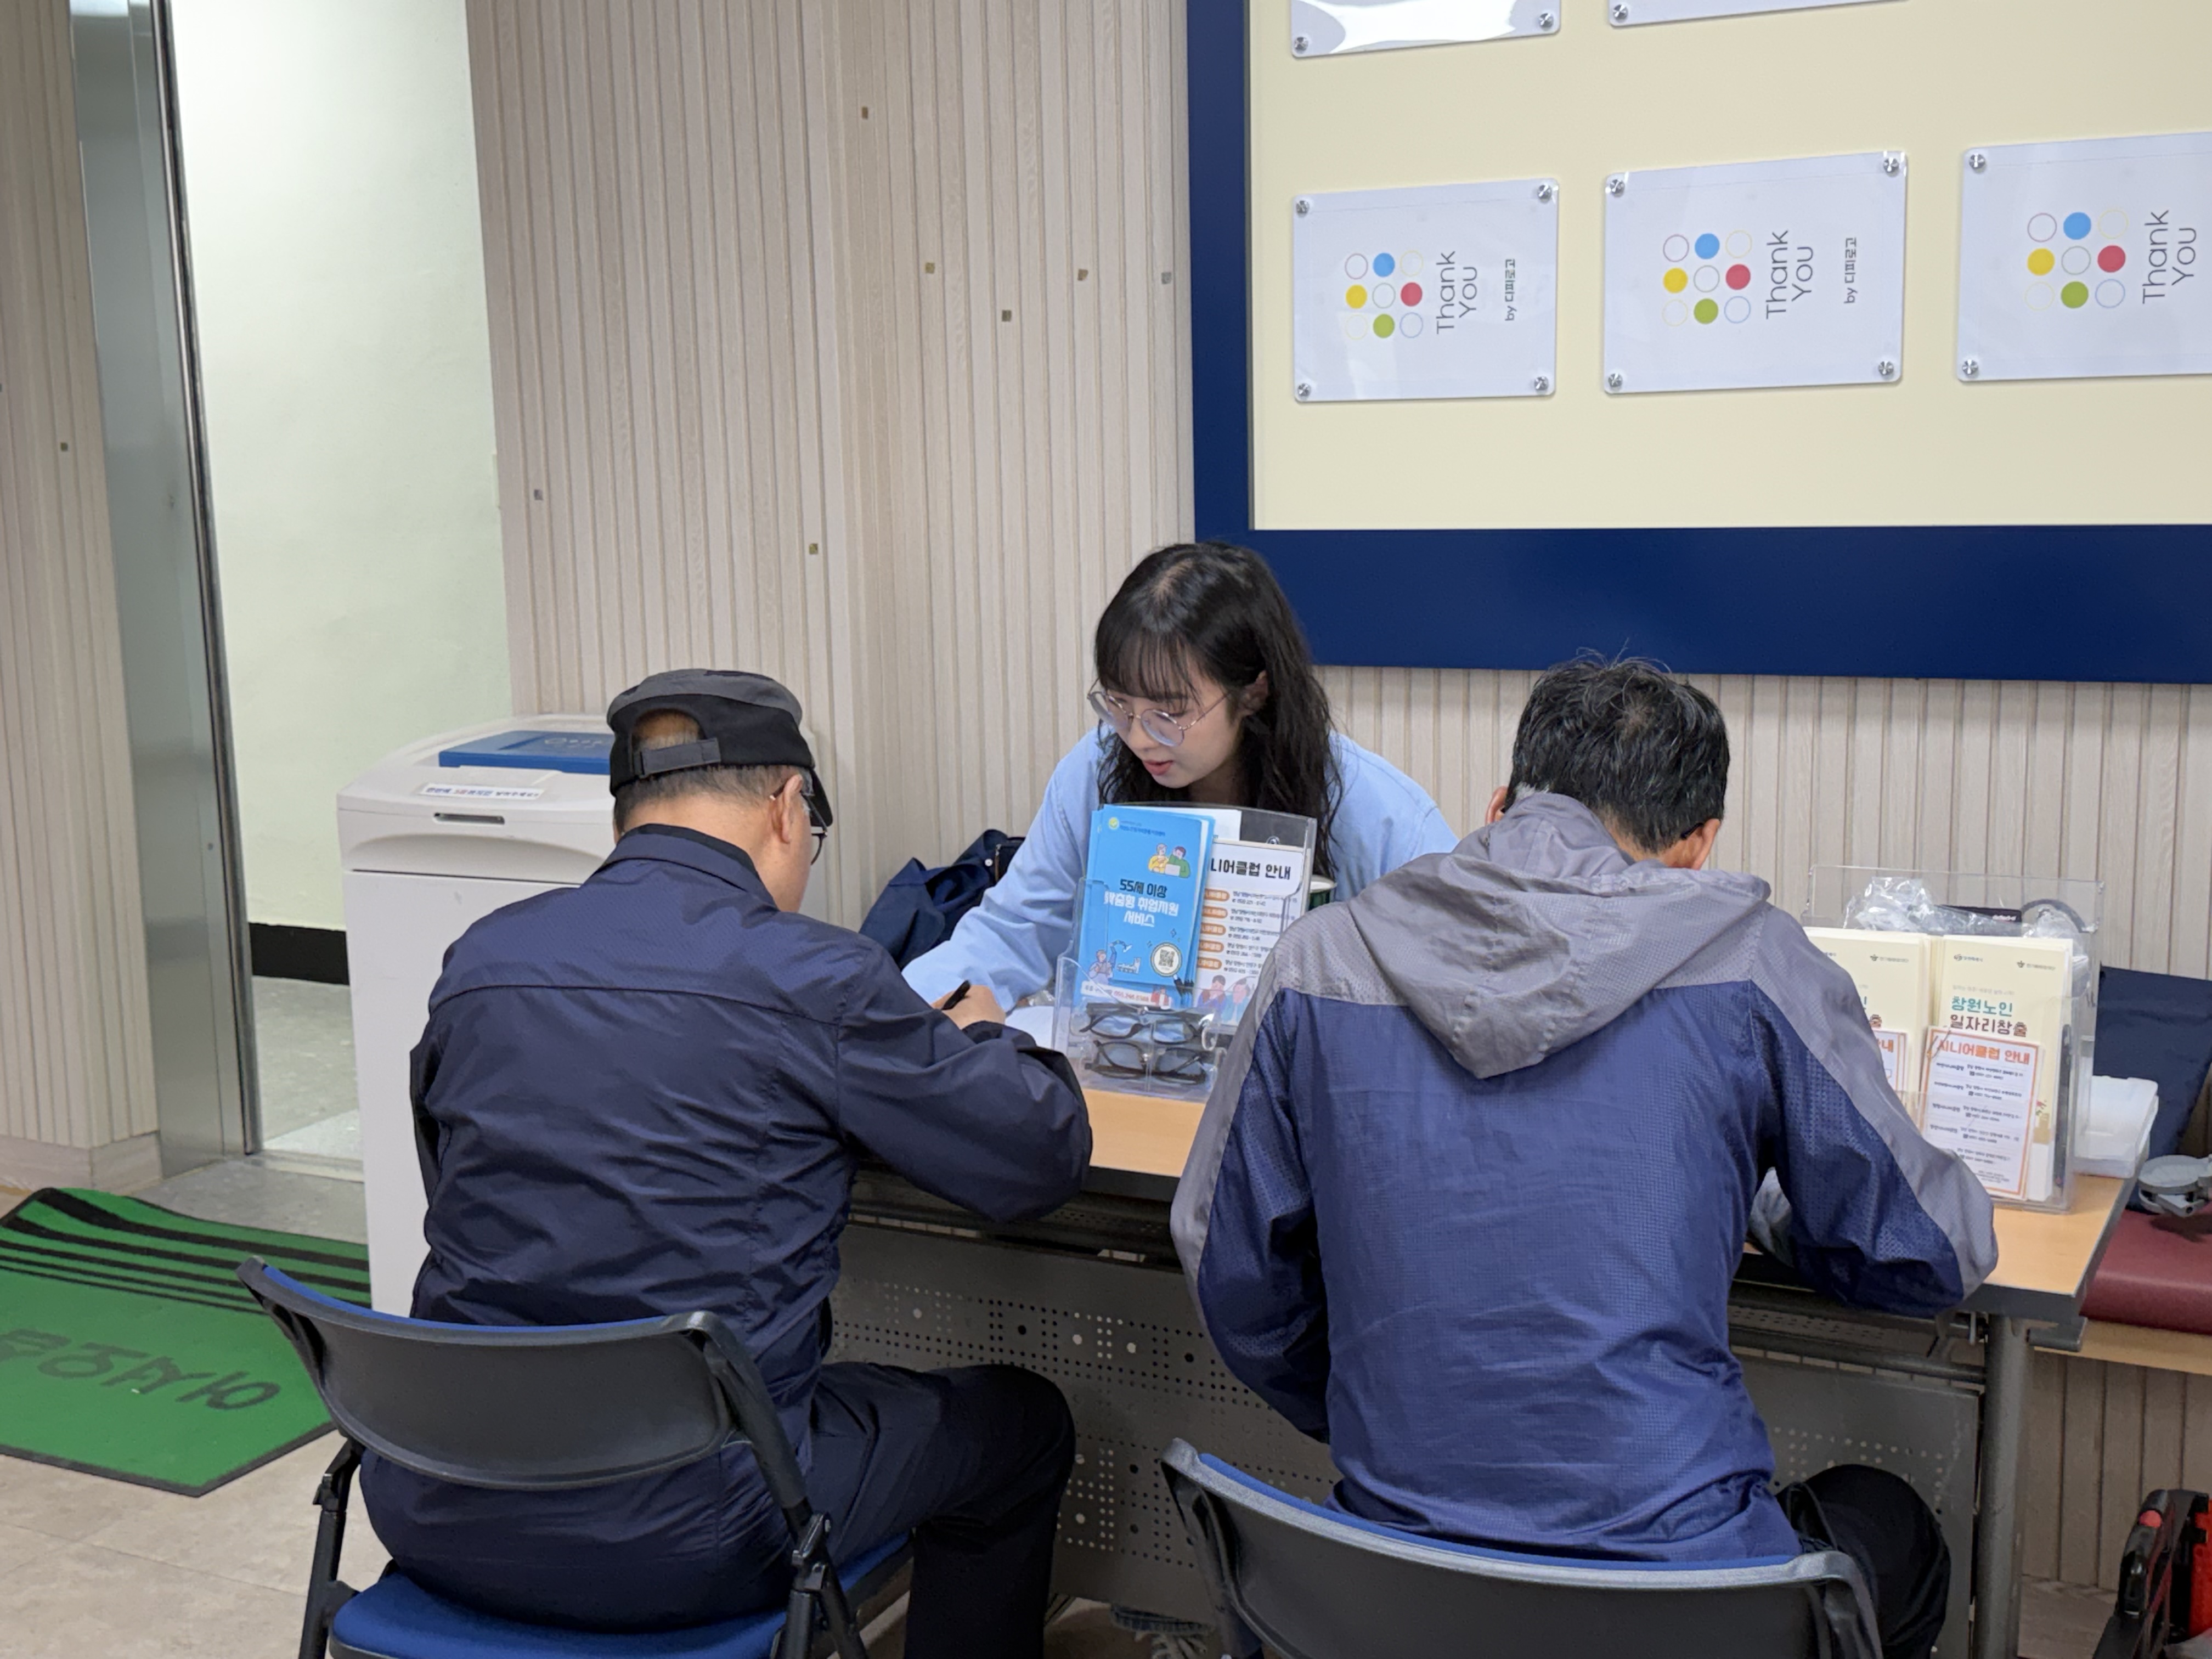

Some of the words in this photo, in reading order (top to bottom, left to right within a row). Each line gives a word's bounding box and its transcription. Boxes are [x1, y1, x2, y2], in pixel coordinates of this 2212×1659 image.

[1844, 237, 1857, 284] 디피로고
[2142, 210, 2169, 304] Thank
[2171, 227, 2197, 286] You
[1504, 258, 1516, 302] 디피로고
[1765, 230, 1788, 320] Thank
[1791, 246, 1814, 302] You
[1436, 251, 1455, 335] Thank
[1459, 266, 1478, 319] You
[1844, 288, 1857, 304] by
[1504, 306, 1517, 321] by
[1265, 864, 1291, 880] 안내
[1120, 878, 1145, 895] 55세
[1147, 883, 1168, 899] 이상
[1124, 910, 1155, 928] 서비스
[1138, 896, 1180, 917] 취업지원
[1951, 996, 2013, 1018] 창원노인
[1950, 1014, 2028, 1037] 일자리창출
[1937, 1040, 2001, 1061] 시니어클럽
[2004, 1049, 2030, 1066] 안내
